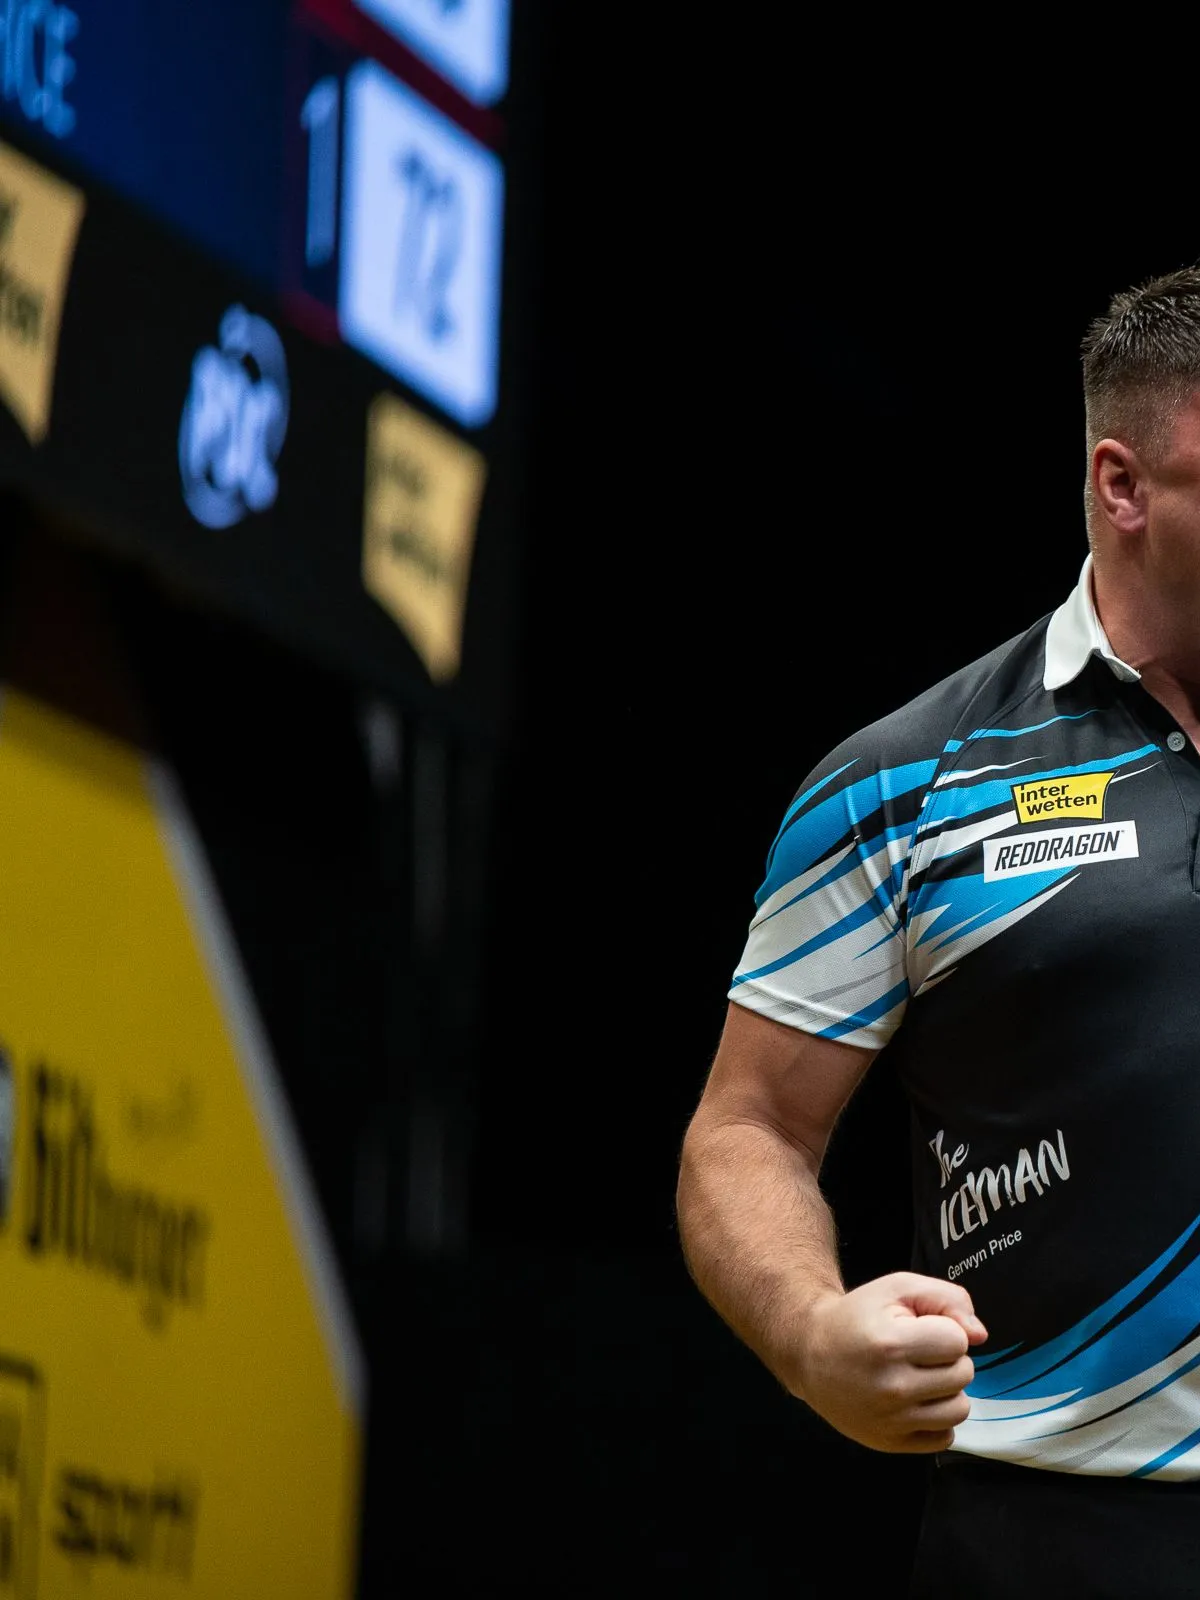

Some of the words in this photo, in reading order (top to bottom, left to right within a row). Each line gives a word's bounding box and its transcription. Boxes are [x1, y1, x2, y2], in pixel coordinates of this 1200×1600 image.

[1020, 783, 1070, 803] inter
[1026, 793, 1098, 816] wetten
[994, 830, 1120, 872] REDDRAGON
[929, 1129, 970, 1189] The
[940, 1128, 1071, 1250] ICEMAN
[947, 1249, 988, 1281] Gerwyn
[988, 1229, 1022, 1256] Price
